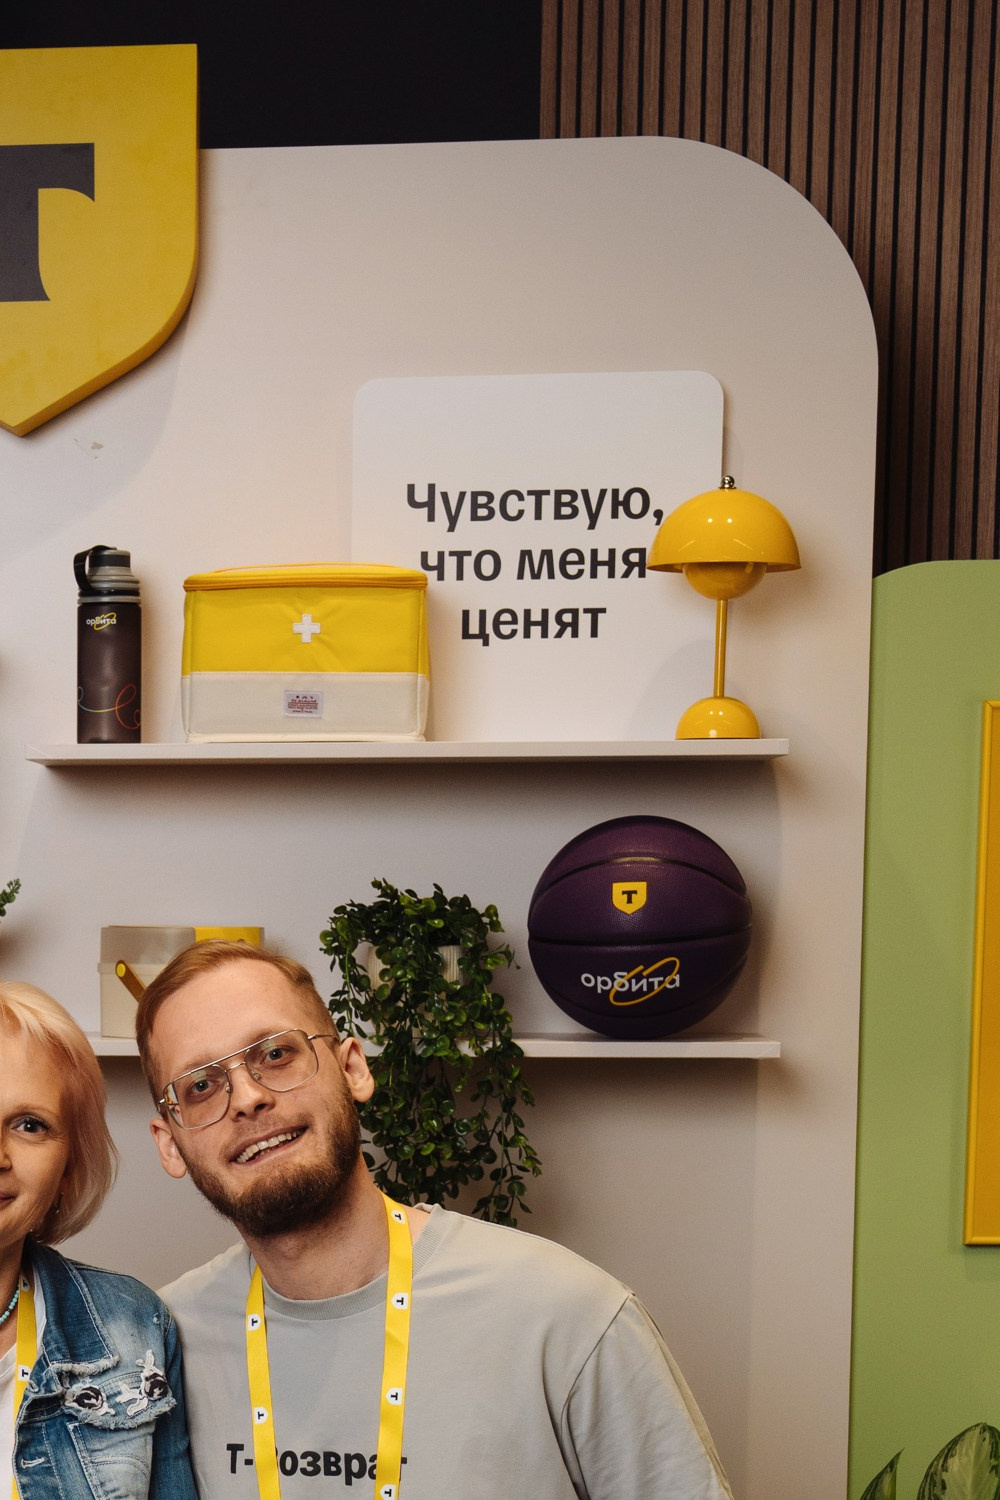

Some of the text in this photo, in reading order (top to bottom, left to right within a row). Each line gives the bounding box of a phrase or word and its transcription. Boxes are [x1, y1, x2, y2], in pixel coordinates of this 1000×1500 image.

[406, 482, 664, 533] Чувствую,
[419, 547, 647, 582] что меня
[461, 607, 607, 647] ценят
[580, 971, 681, 994] орбита
